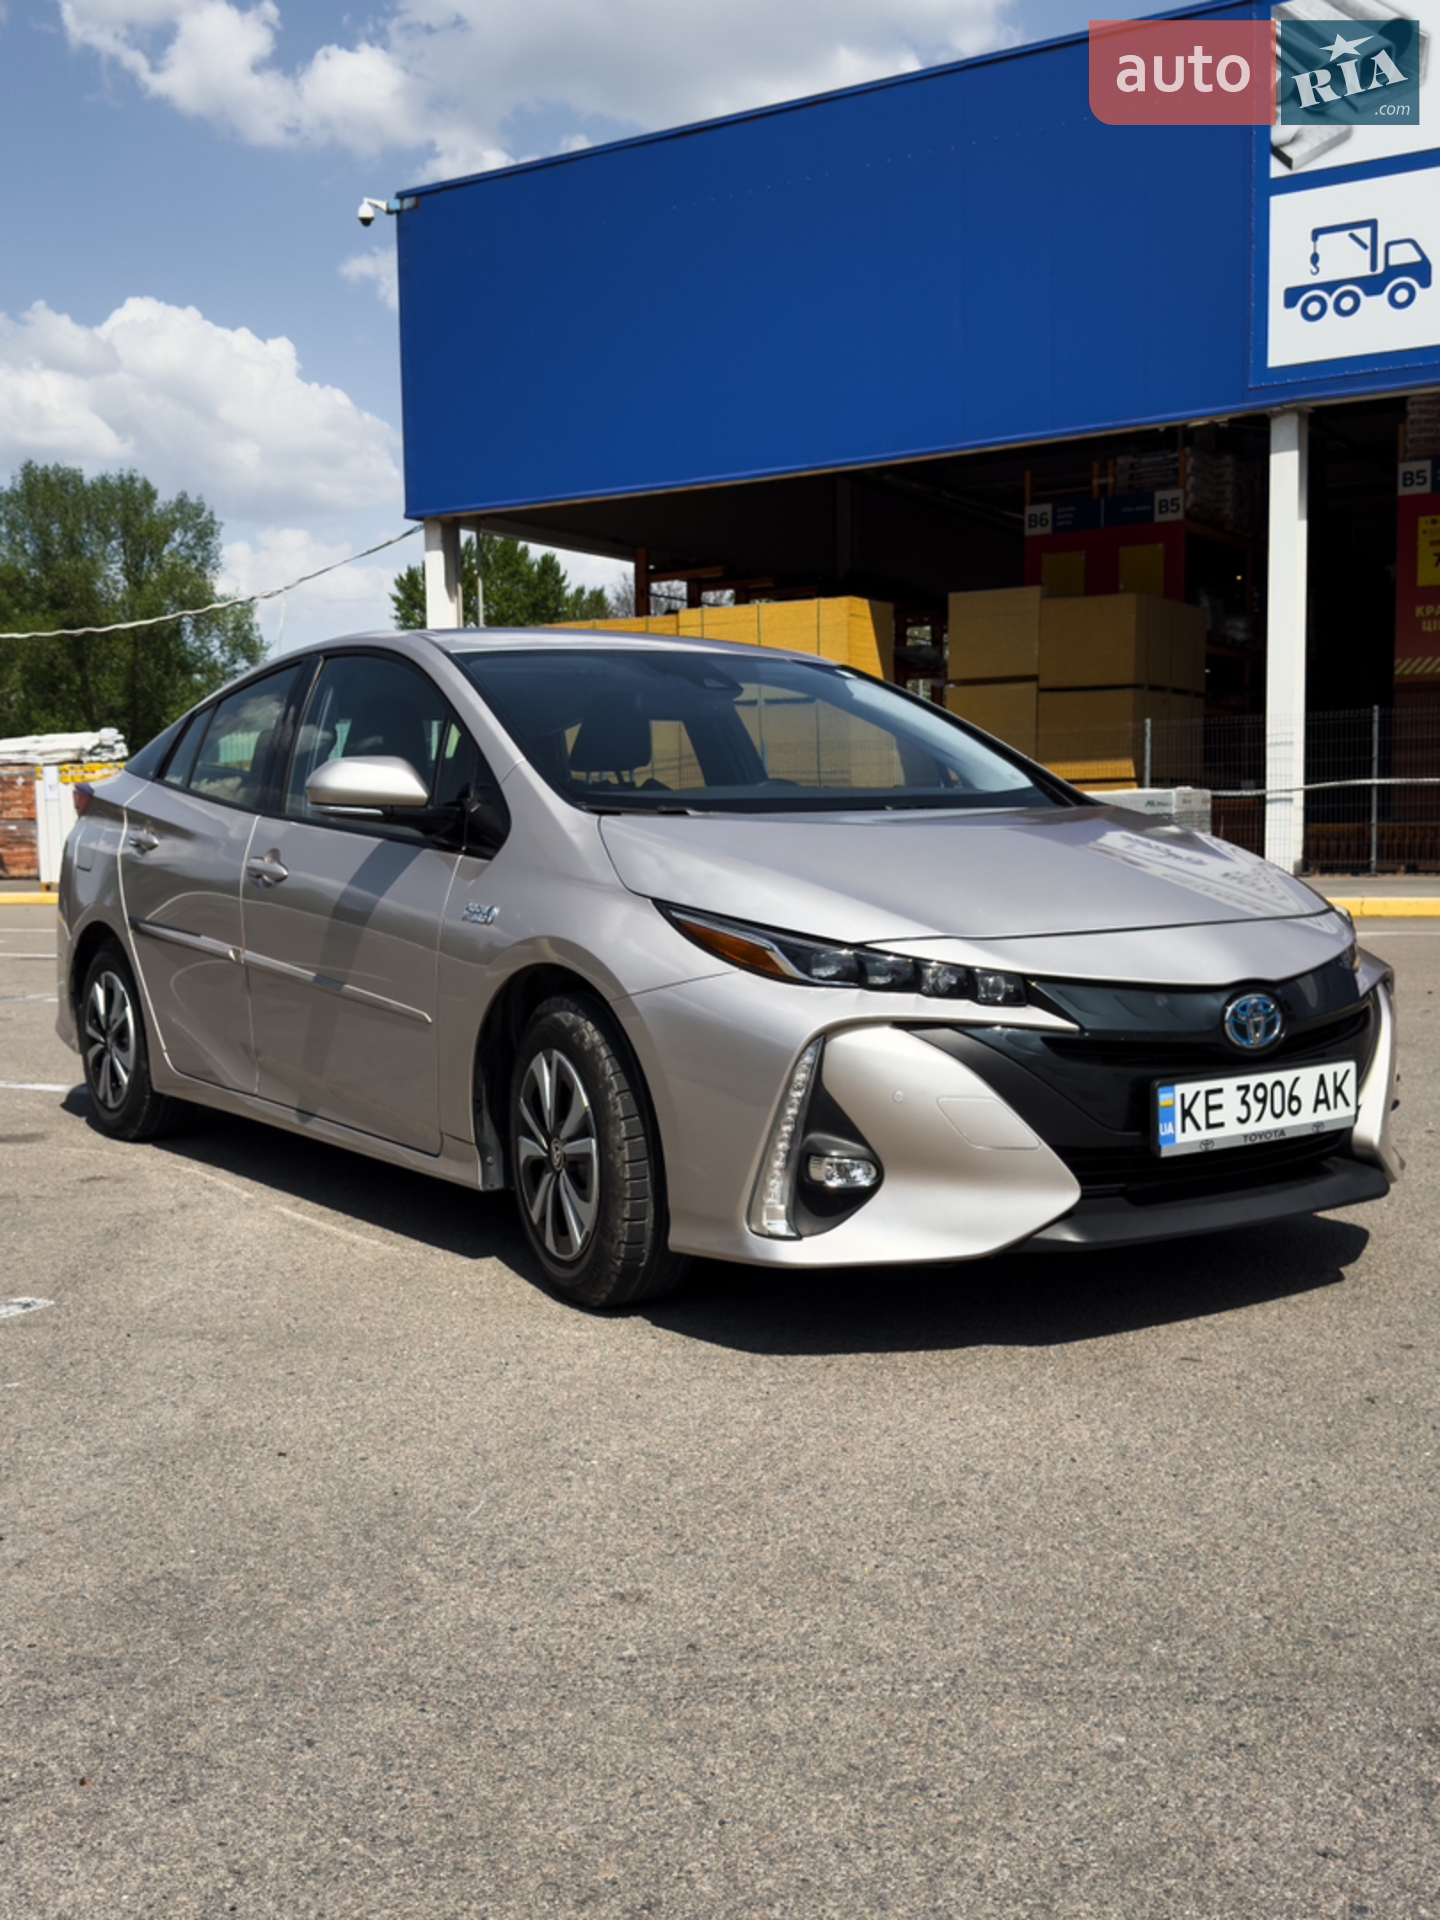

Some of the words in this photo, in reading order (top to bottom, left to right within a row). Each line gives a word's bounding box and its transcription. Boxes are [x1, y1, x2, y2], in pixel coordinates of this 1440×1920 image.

[1402, 470, 1428, 488] B5
[1158, 497, 1181, 515] B5
[1028, 513, 1050, 529] B6
[1180, 1088, 1225, 1133] KE
[1236, 1077, 1302, 1125] 3906
[1312, 1069, 1351, 1113] AK
[1159, 1122, 1174, 1136] UA
[1242, 1129, 1286, 1143] TOYOTA
